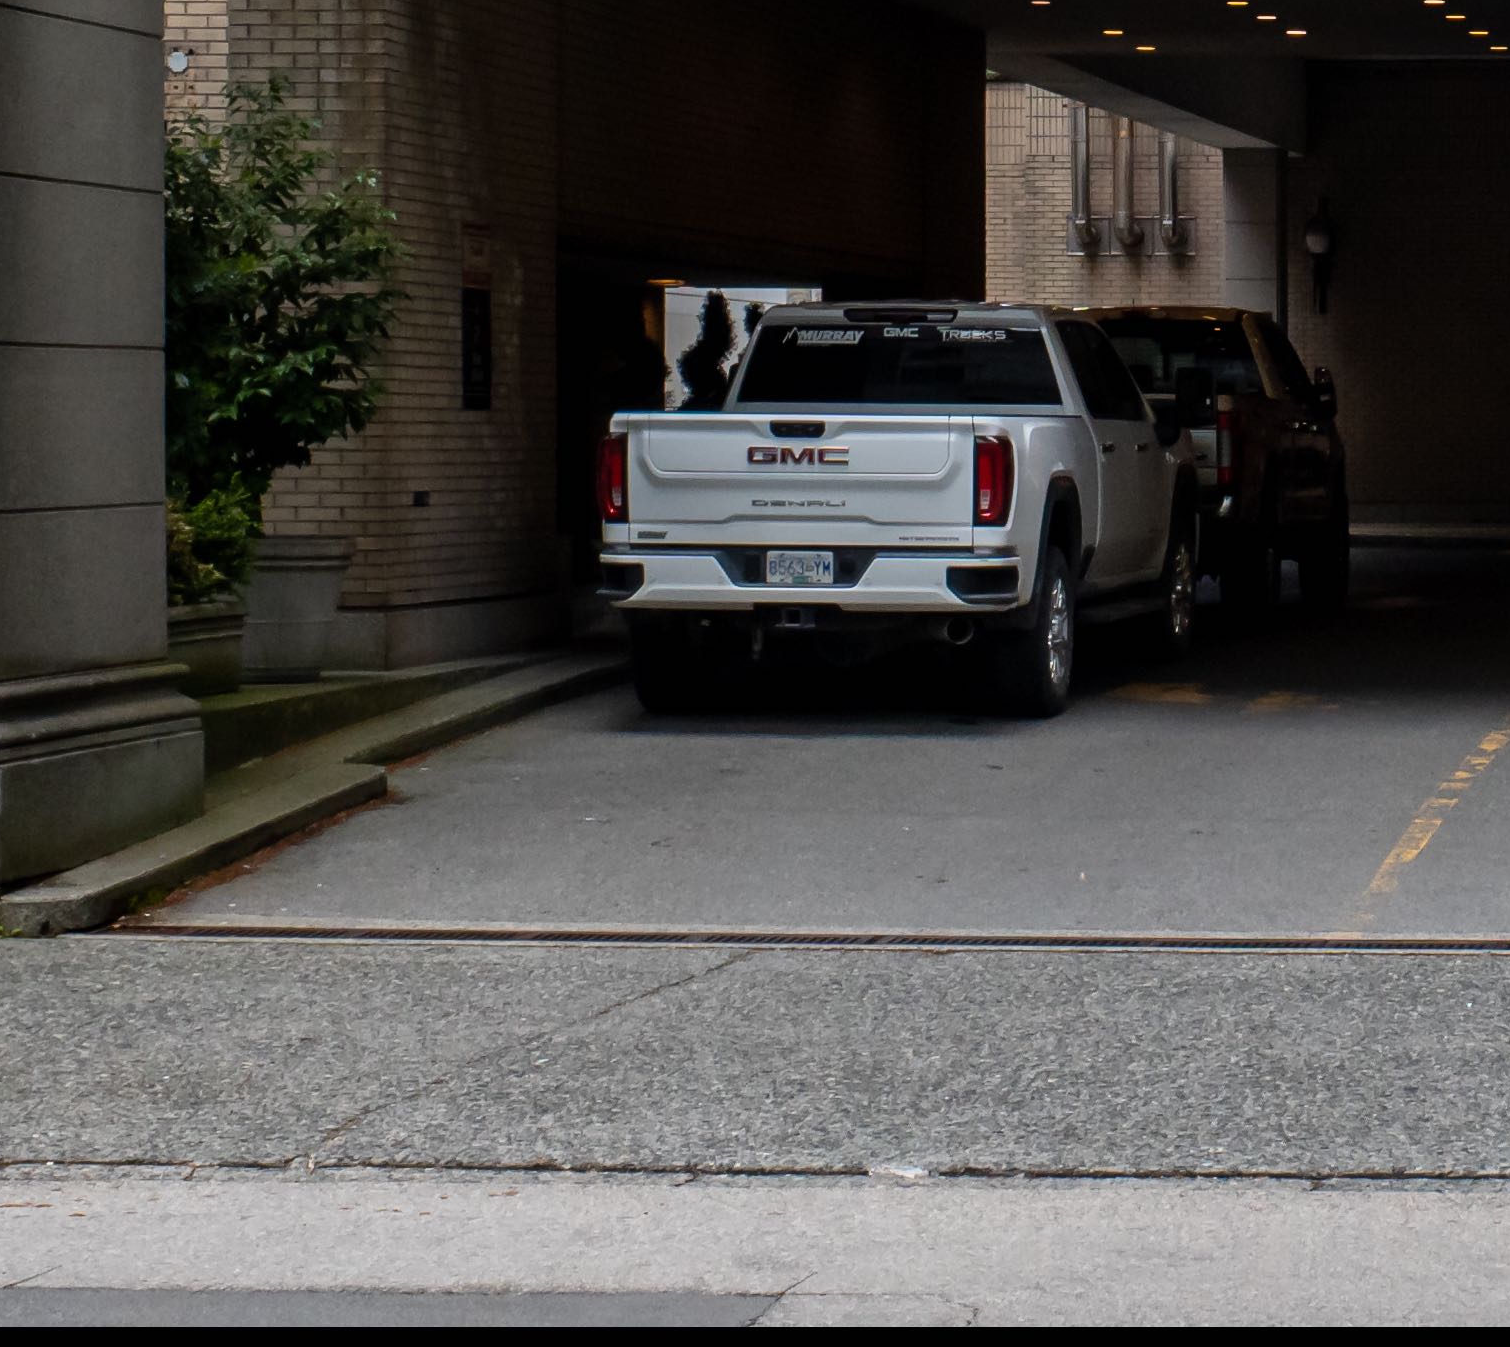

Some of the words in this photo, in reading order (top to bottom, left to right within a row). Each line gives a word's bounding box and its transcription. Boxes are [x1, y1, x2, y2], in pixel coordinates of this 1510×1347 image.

[799, 329, 865, 343] MURRAY
[883, 327, 919, 338] GMC
[746, 445, 850, 466] GMC
[751, 499, 847, 507] DENALI
